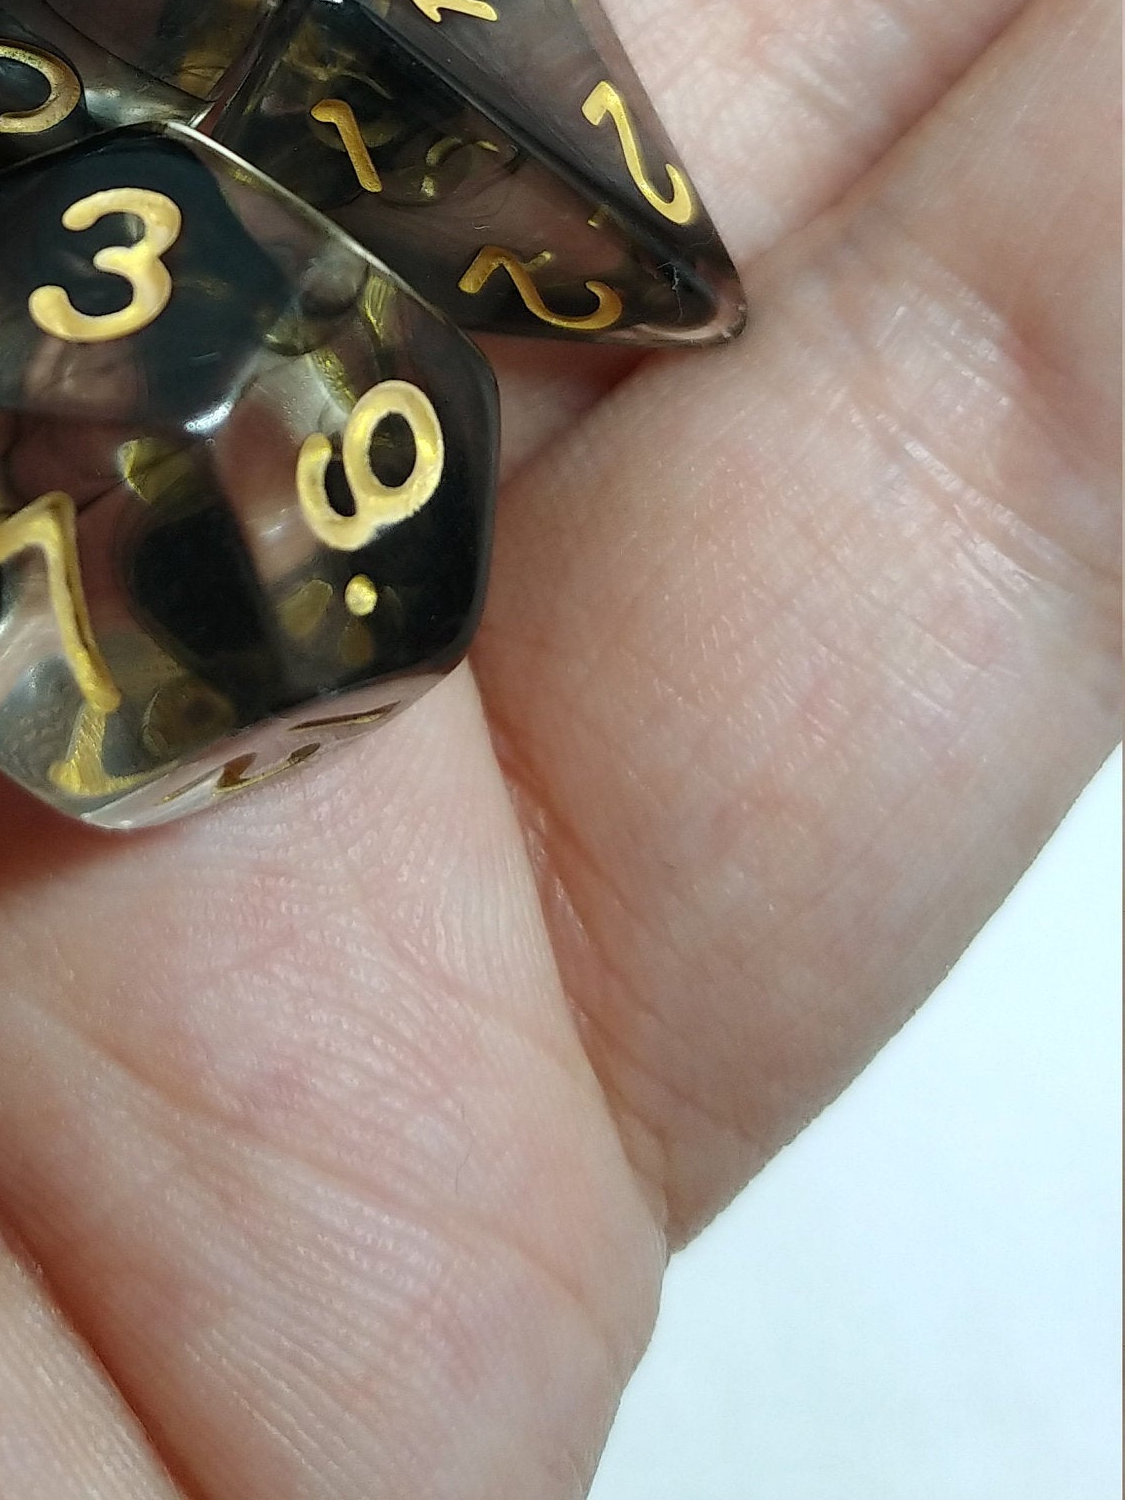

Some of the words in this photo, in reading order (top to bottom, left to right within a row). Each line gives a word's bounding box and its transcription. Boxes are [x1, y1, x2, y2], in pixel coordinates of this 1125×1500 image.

[310, 98, 382, 192] 1
[582, 80, 695, 225] 2
[28, 186, 183, 342] 3
[459, 244, 623, 330] 2
